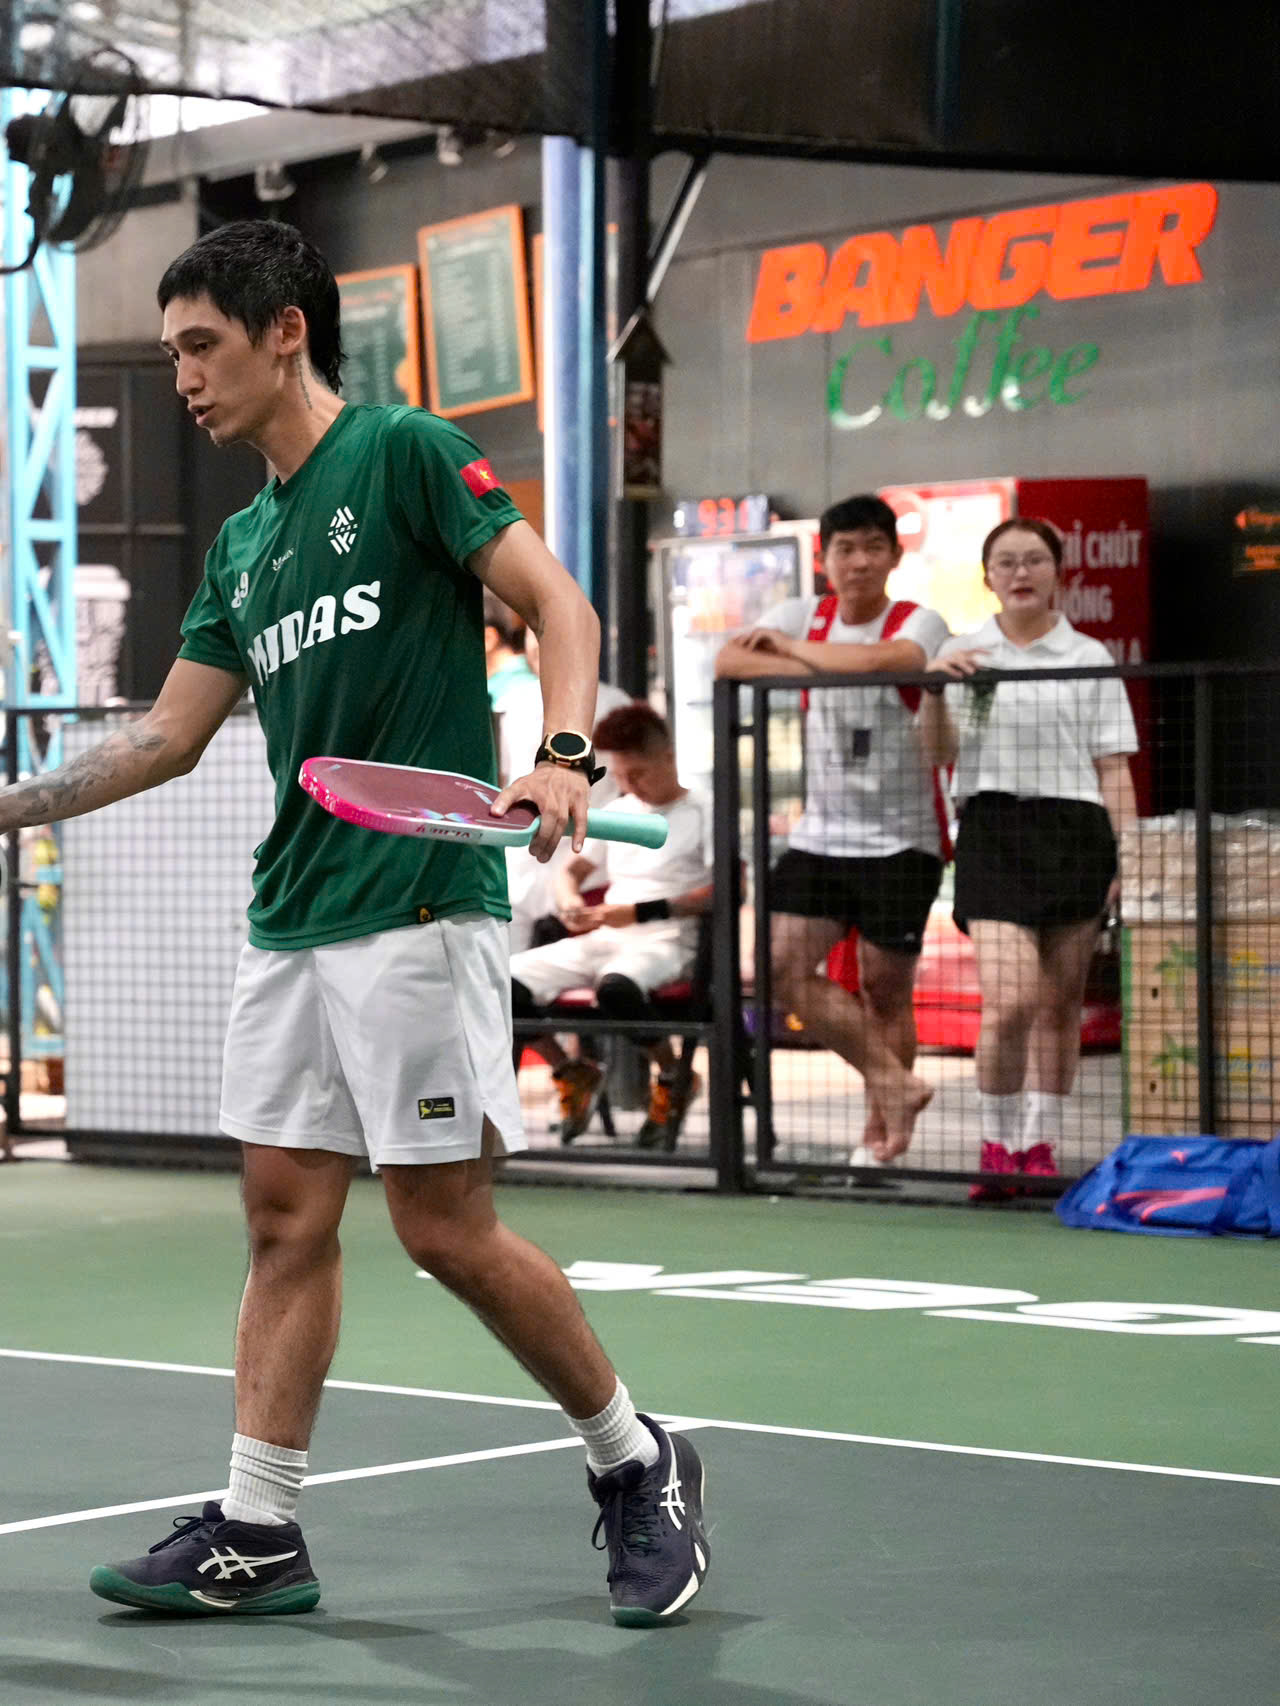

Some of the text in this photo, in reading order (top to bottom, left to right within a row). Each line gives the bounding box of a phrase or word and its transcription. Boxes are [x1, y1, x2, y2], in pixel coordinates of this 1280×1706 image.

[746, 182, 1218, 344] BANGER
[827, 303, 1100, 430] Coffee
[247, 580, 382, 687] MIDAS
